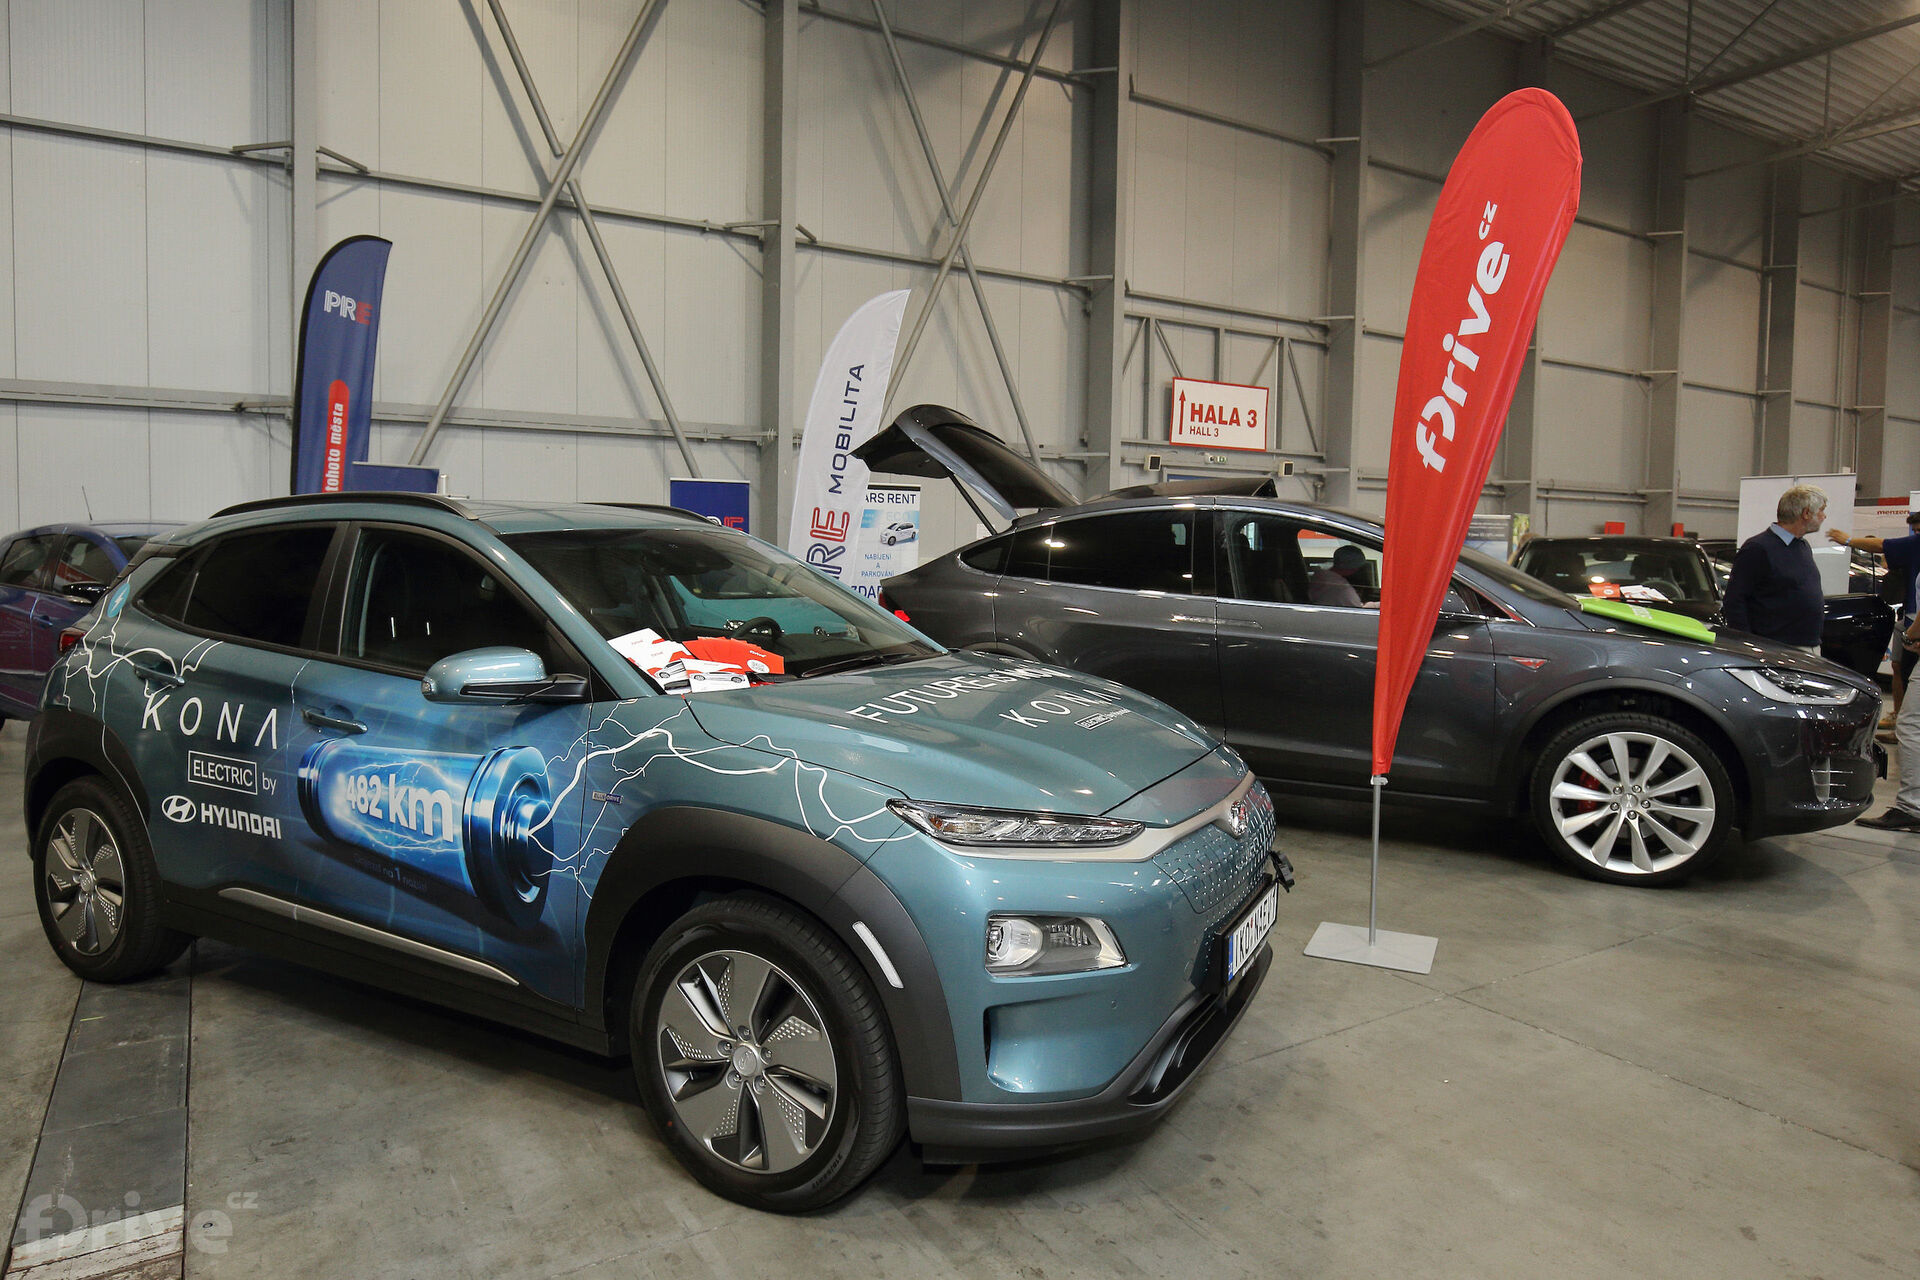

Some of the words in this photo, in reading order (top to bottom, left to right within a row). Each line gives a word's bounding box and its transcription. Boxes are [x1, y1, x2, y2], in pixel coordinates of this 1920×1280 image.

[324, 290, 373, 326] PRE
[1416, 241, 1510, 473] fDrive
[330, 402, 344, 445] města
[1189, 426, 1211, 437] HALL
[1214, 427, 1219, 438] 3
[1190, 402, 1240, 427] HALA
[1247, 409, 1258, 429] 3
[325, 448, 341, 492] tohoto
[805, 506, 850, 579] RE
[828, 364, 865, 495] MOBILITA
[887, 493, 917, 505] RENT
[845, 675, 997, 724] FUTURE
[193, 759, 253, 787] ELECTRIC
[262, 772, 277, 795] by
[201, 802, 282, 840] HYUNDAI
[347, 774, 383, 819] 482
[388, 773, 453, 843] km
